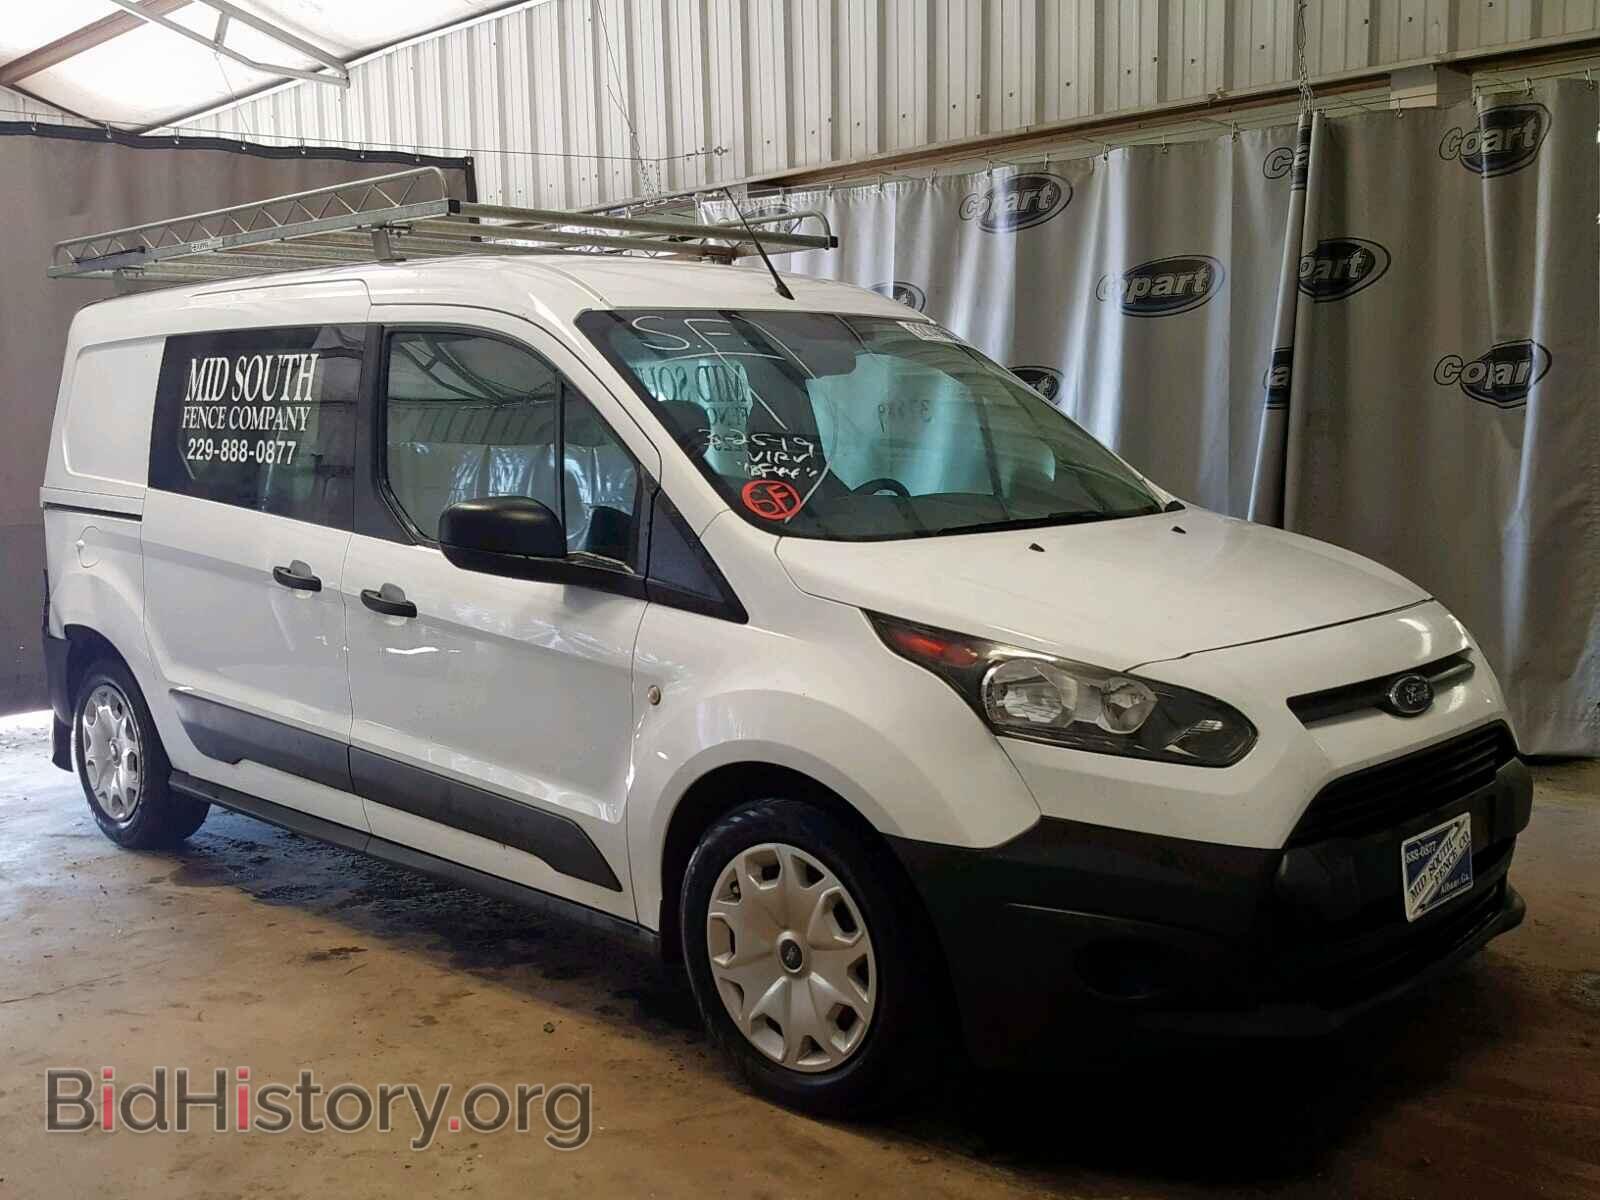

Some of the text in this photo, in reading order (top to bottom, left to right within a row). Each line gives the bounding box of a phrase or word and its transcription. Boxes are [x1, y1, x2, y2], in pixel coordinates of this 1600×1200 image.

[185, 353, 319, 402] MID SOUTH
[182, 405, 311, 431] FENCE COMPANY
[187, 438, 297, 465] 229-888-0877
